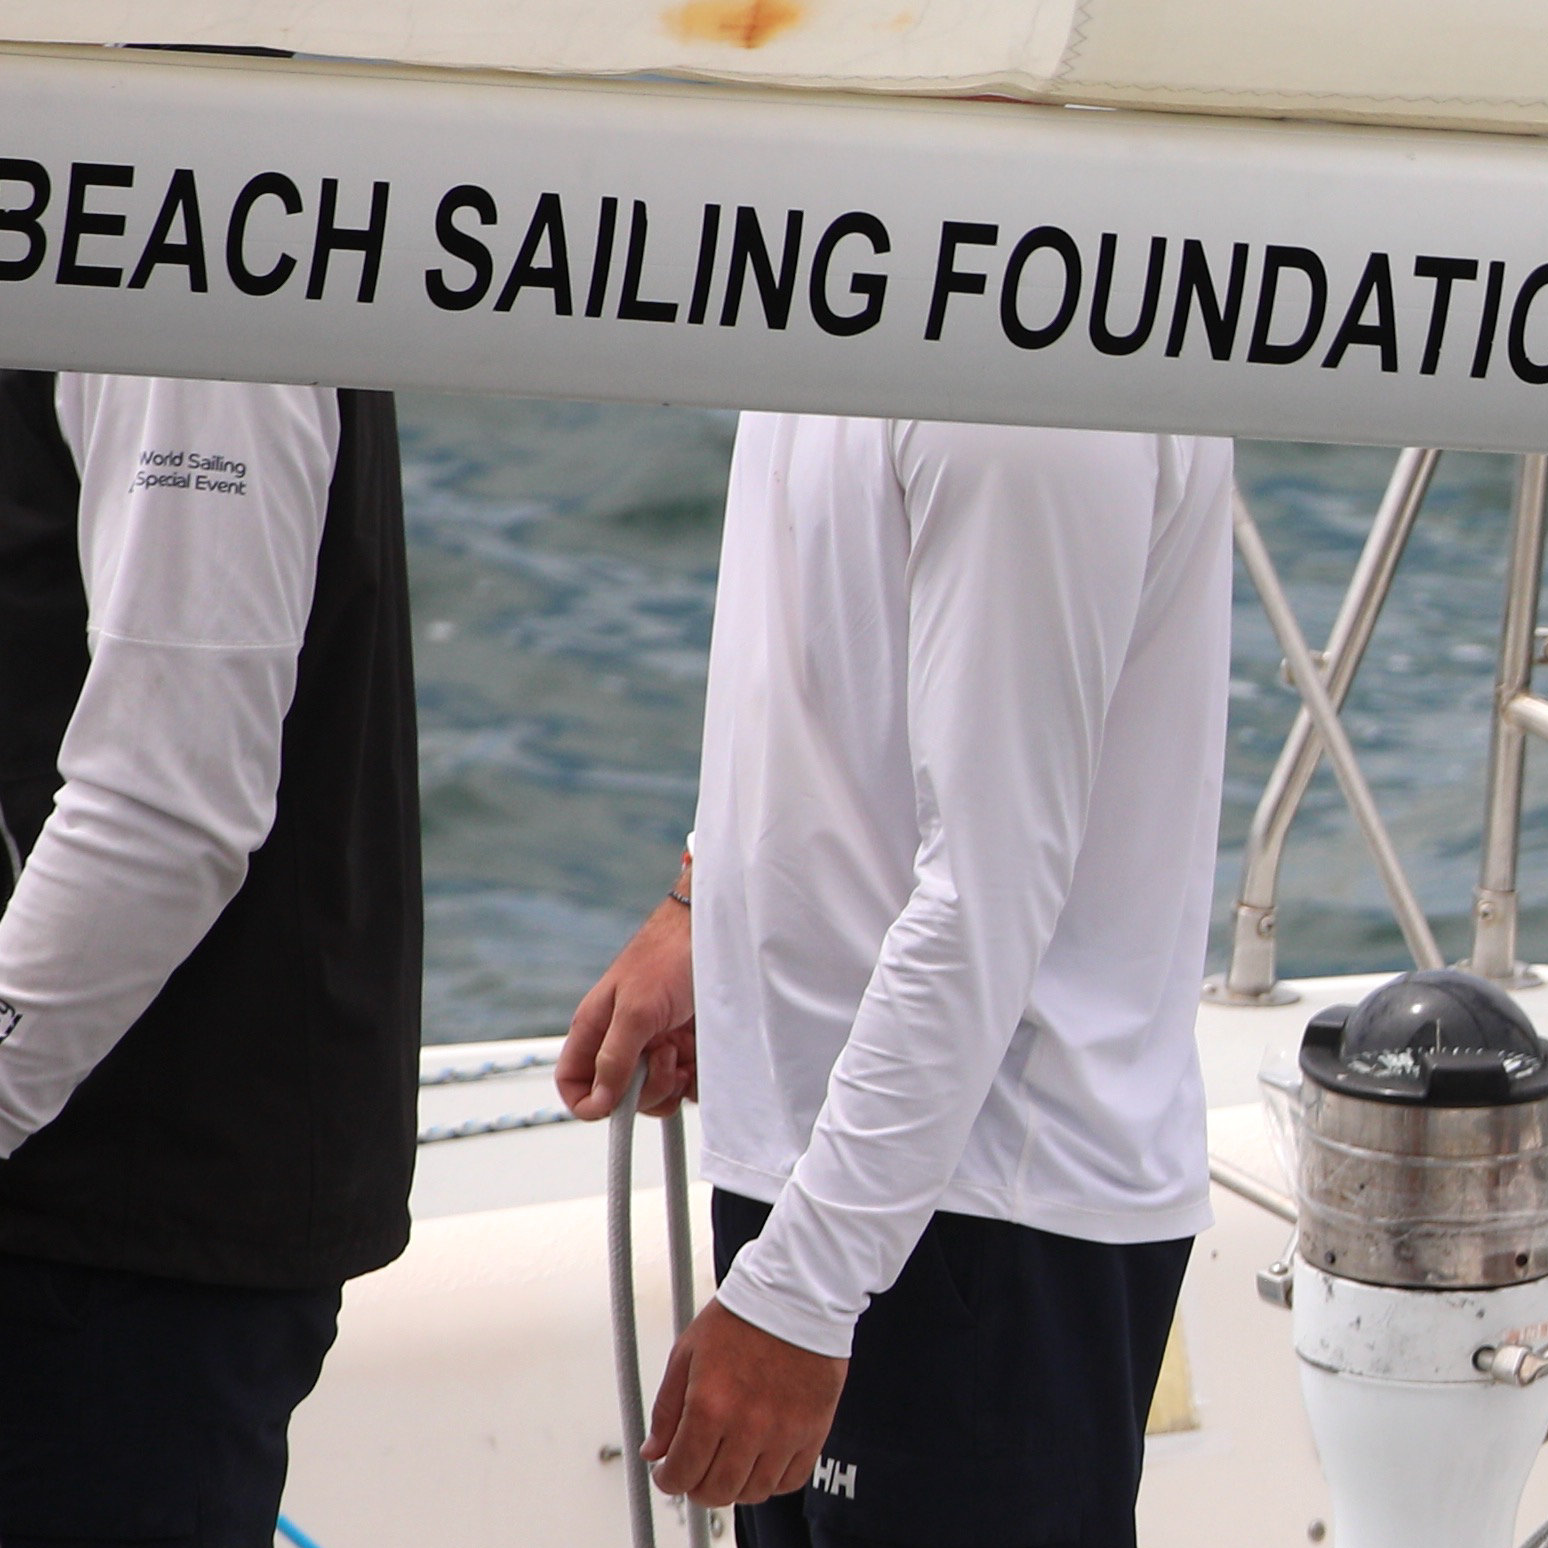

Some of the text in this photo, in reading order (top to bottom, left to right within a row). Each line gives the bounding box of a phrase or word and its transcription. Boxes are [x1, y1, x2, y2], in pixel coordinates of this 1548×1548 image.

[0, 158, 390, 304] BEACH
[425, 185, 891, 337] SAILING
[140, 451, 247, 479] World Sailing
[130, 471, 247, 496] Special Event
[812, 1454, 857, 1499] HH
